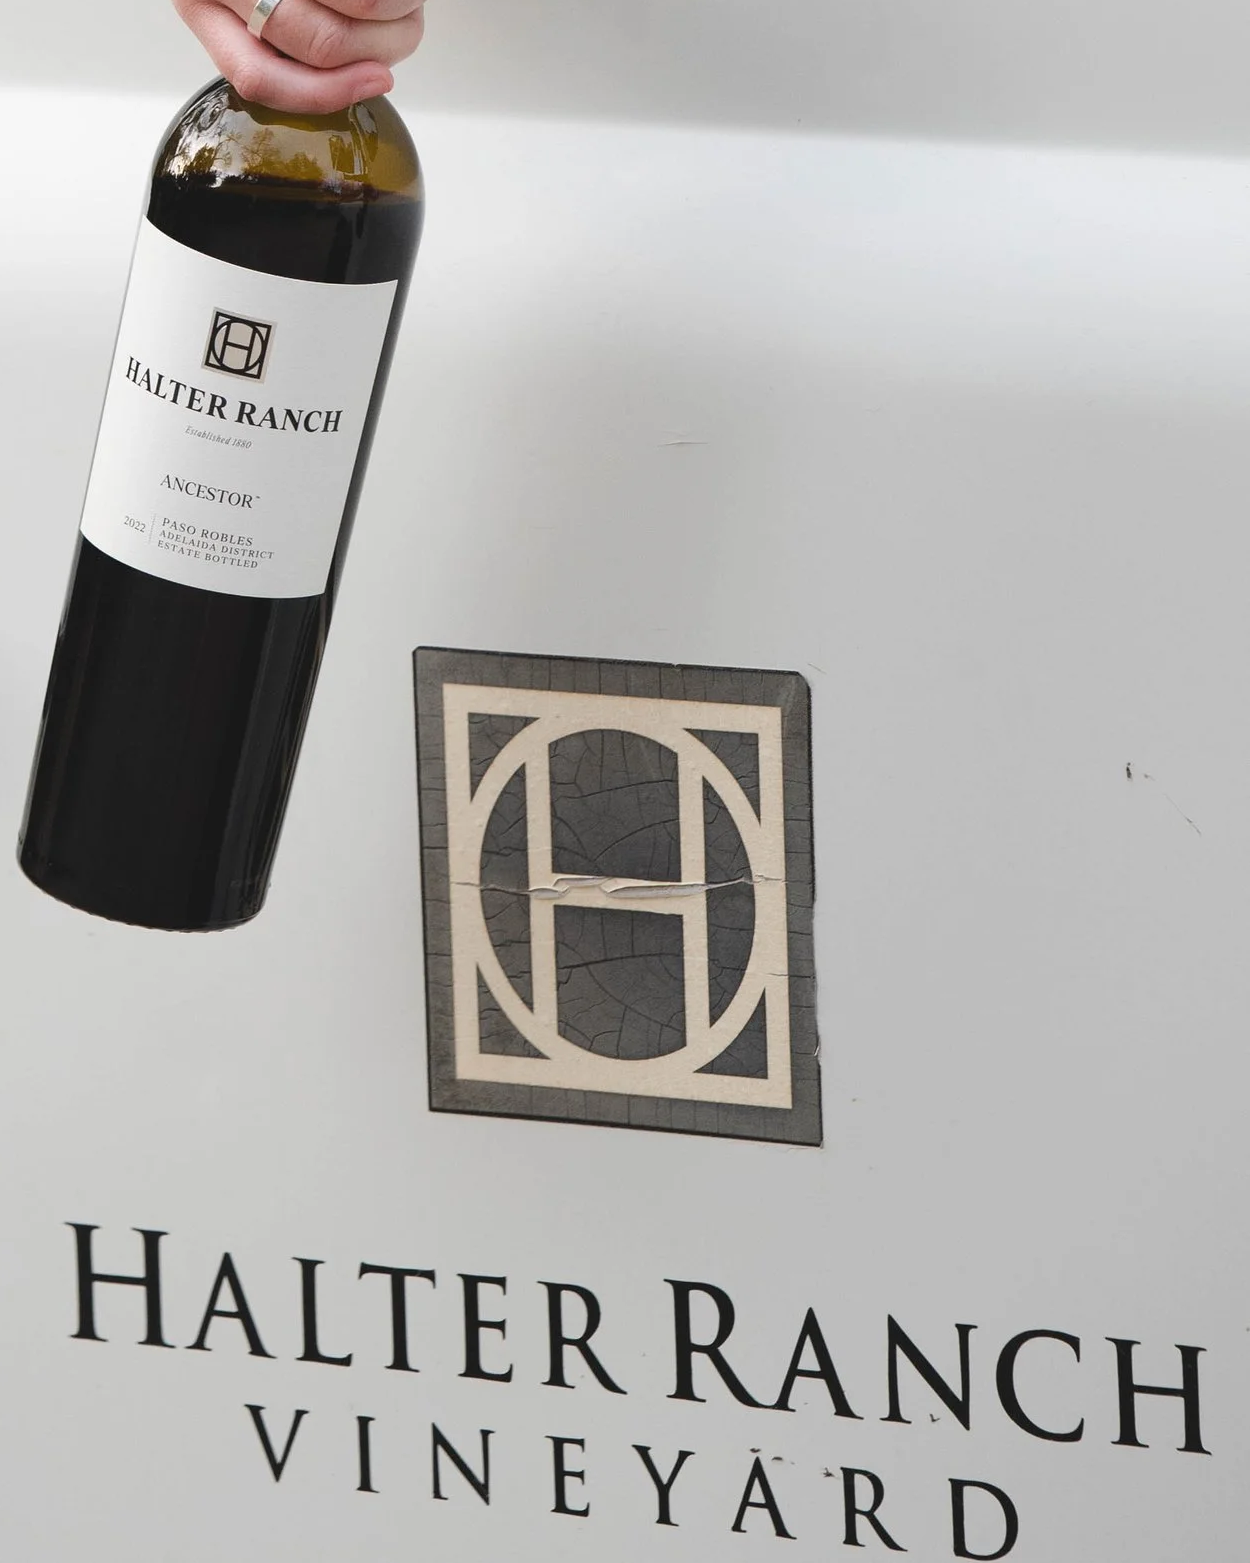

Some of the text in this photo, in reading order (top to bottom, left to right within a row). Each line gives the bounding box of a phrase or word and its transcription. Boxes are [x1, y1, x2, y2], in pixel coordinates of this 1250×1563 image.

[125, 356, 343, 433] HALTER RANCH
[184, 425, 252, 449] Established 1880
[123, 515, 146, 533] 2022
[161, 517, 253, 546] PASO ROBLES
[157, 539, 258, 568] ESTATE BOTTLED
[159, 529, 275, 559] ADELAIDA DISTRICT
[67, 1223, 1213, 1456] HALTER RANCH
[245, 1404, 1019, 1562] VINEYARD
